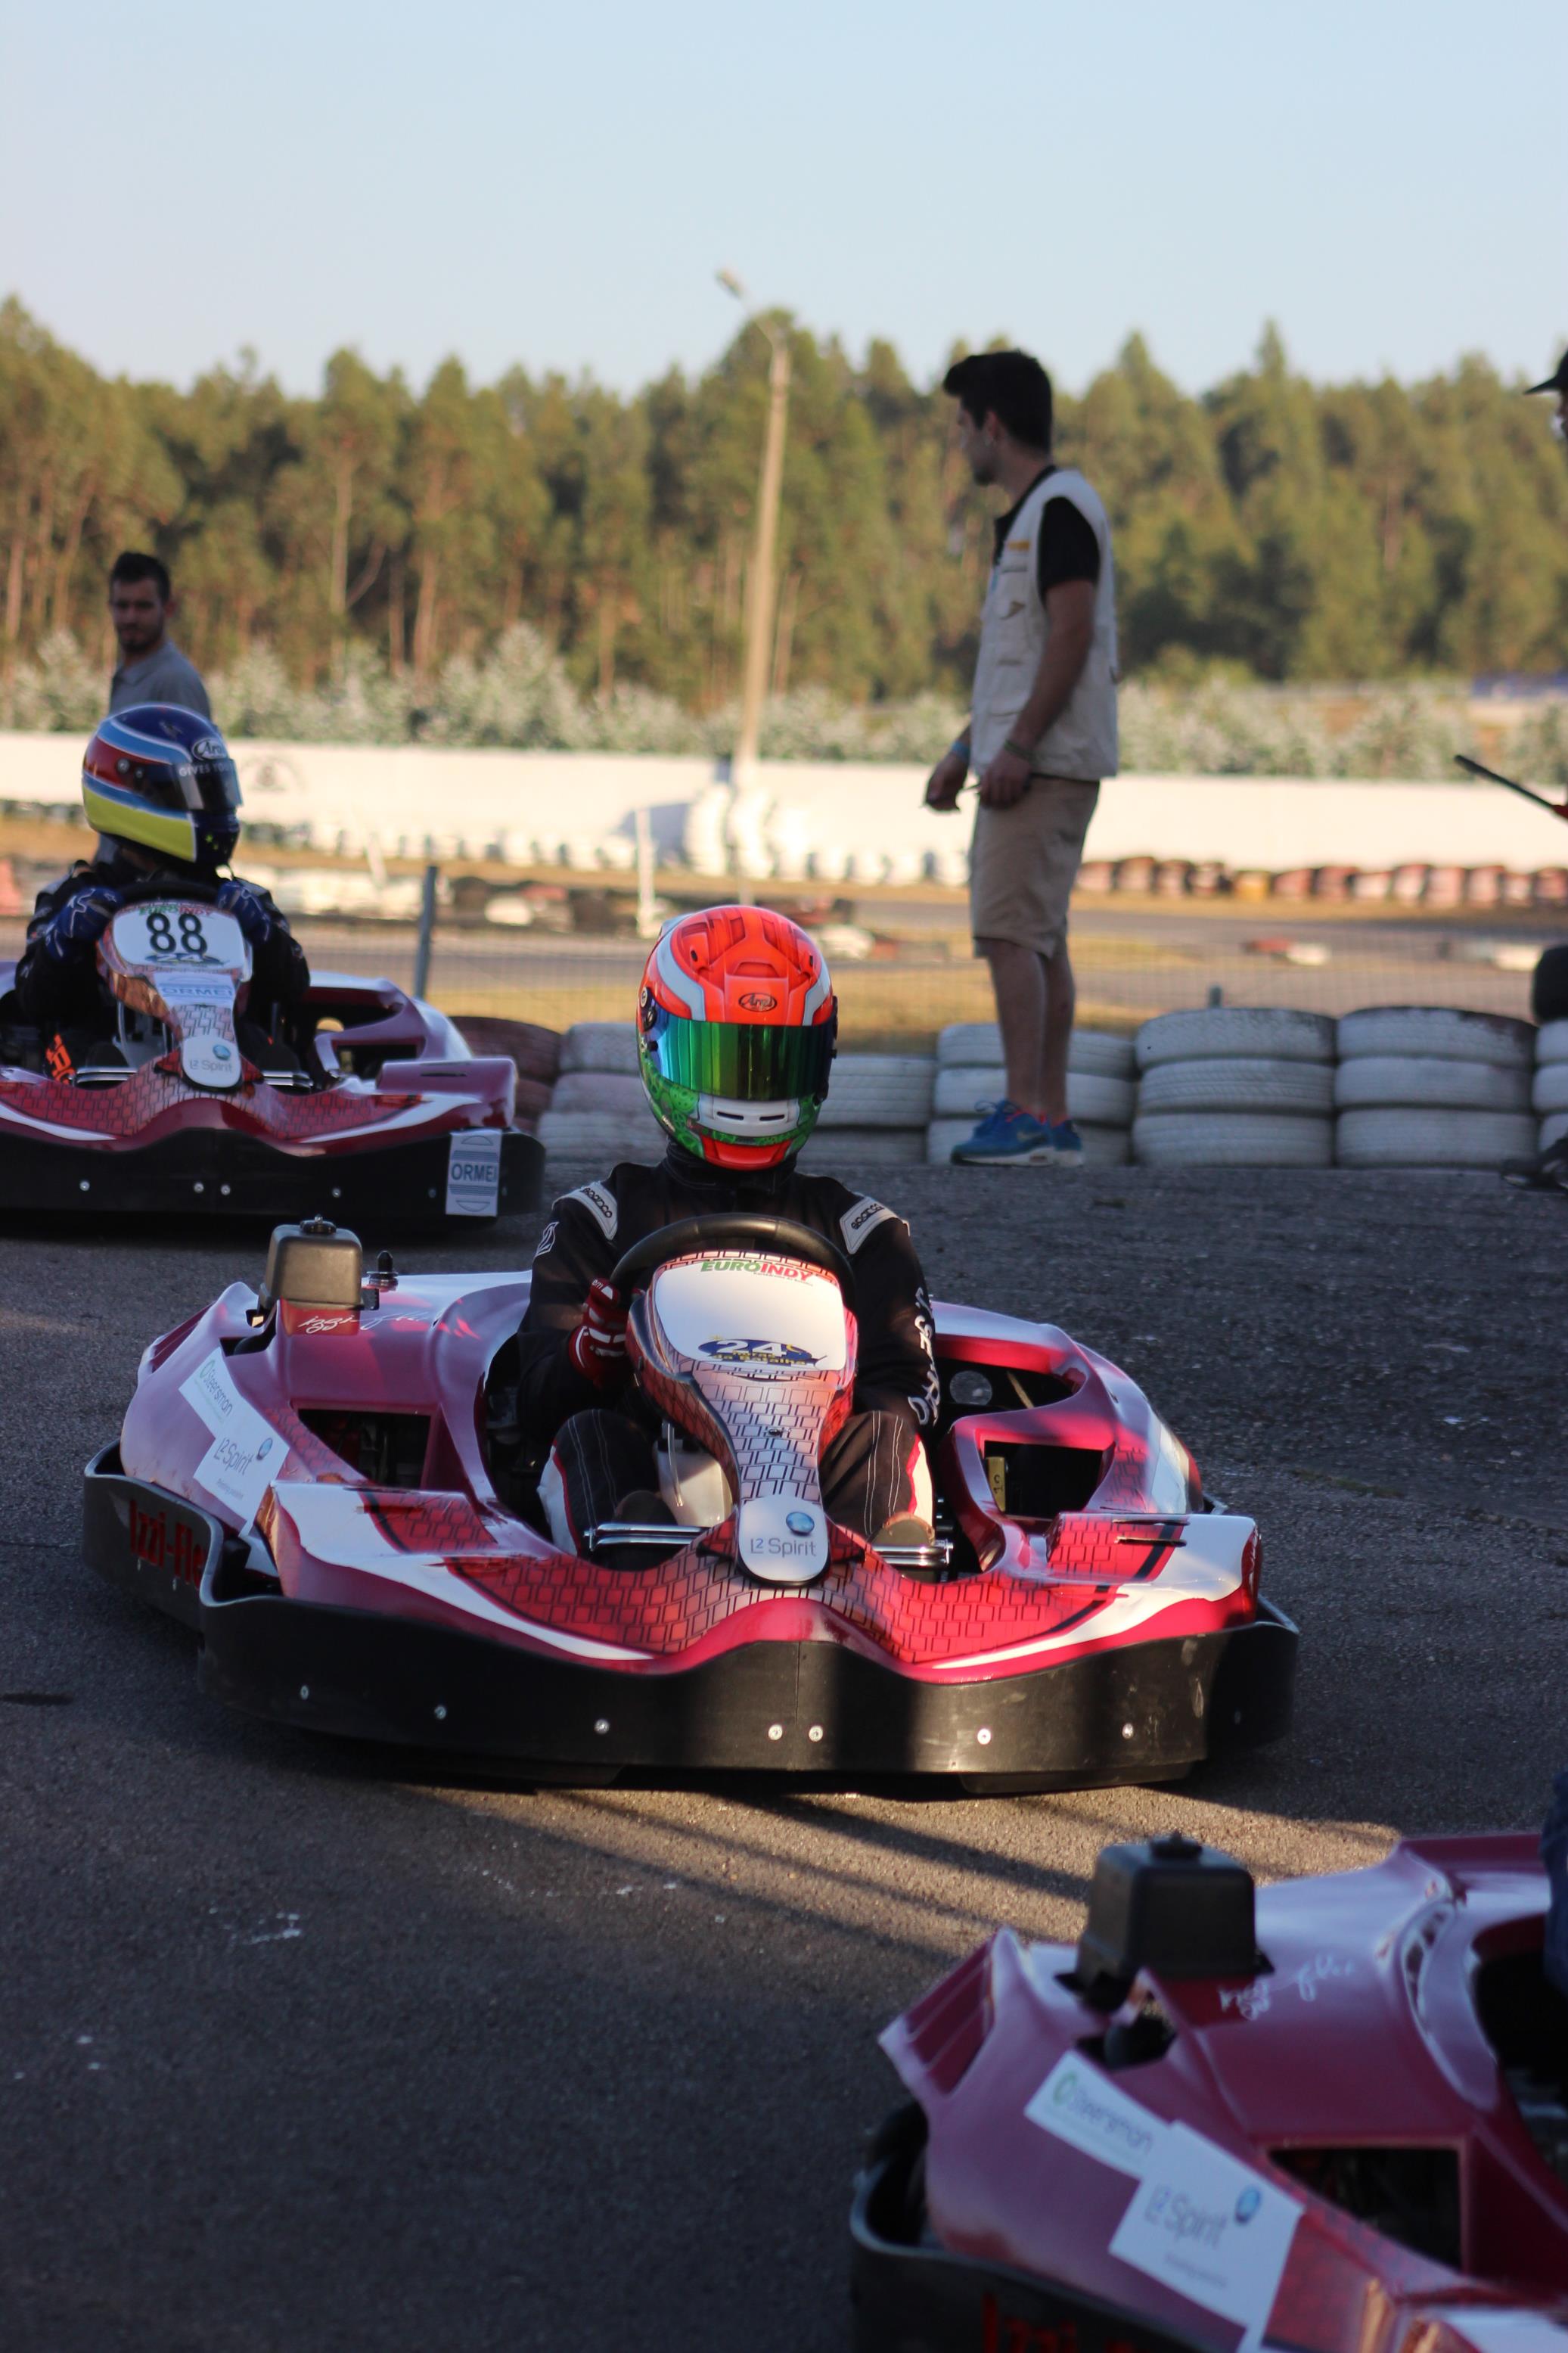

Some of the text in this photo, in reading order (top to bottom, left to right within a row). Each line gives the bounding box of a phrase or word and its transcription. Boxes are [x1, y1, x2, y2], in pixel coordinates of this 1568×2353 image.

[146, 912, 208, 954] 88
[201, 1059, 232, 1073] Spirit
[700, 1260, 812, 1281] EUROINDY
[716, 1340, 787, 1358] 24
[222, 1442, 254, 1476] Spirit
[768, 1537, 816, 1558] Spirit
